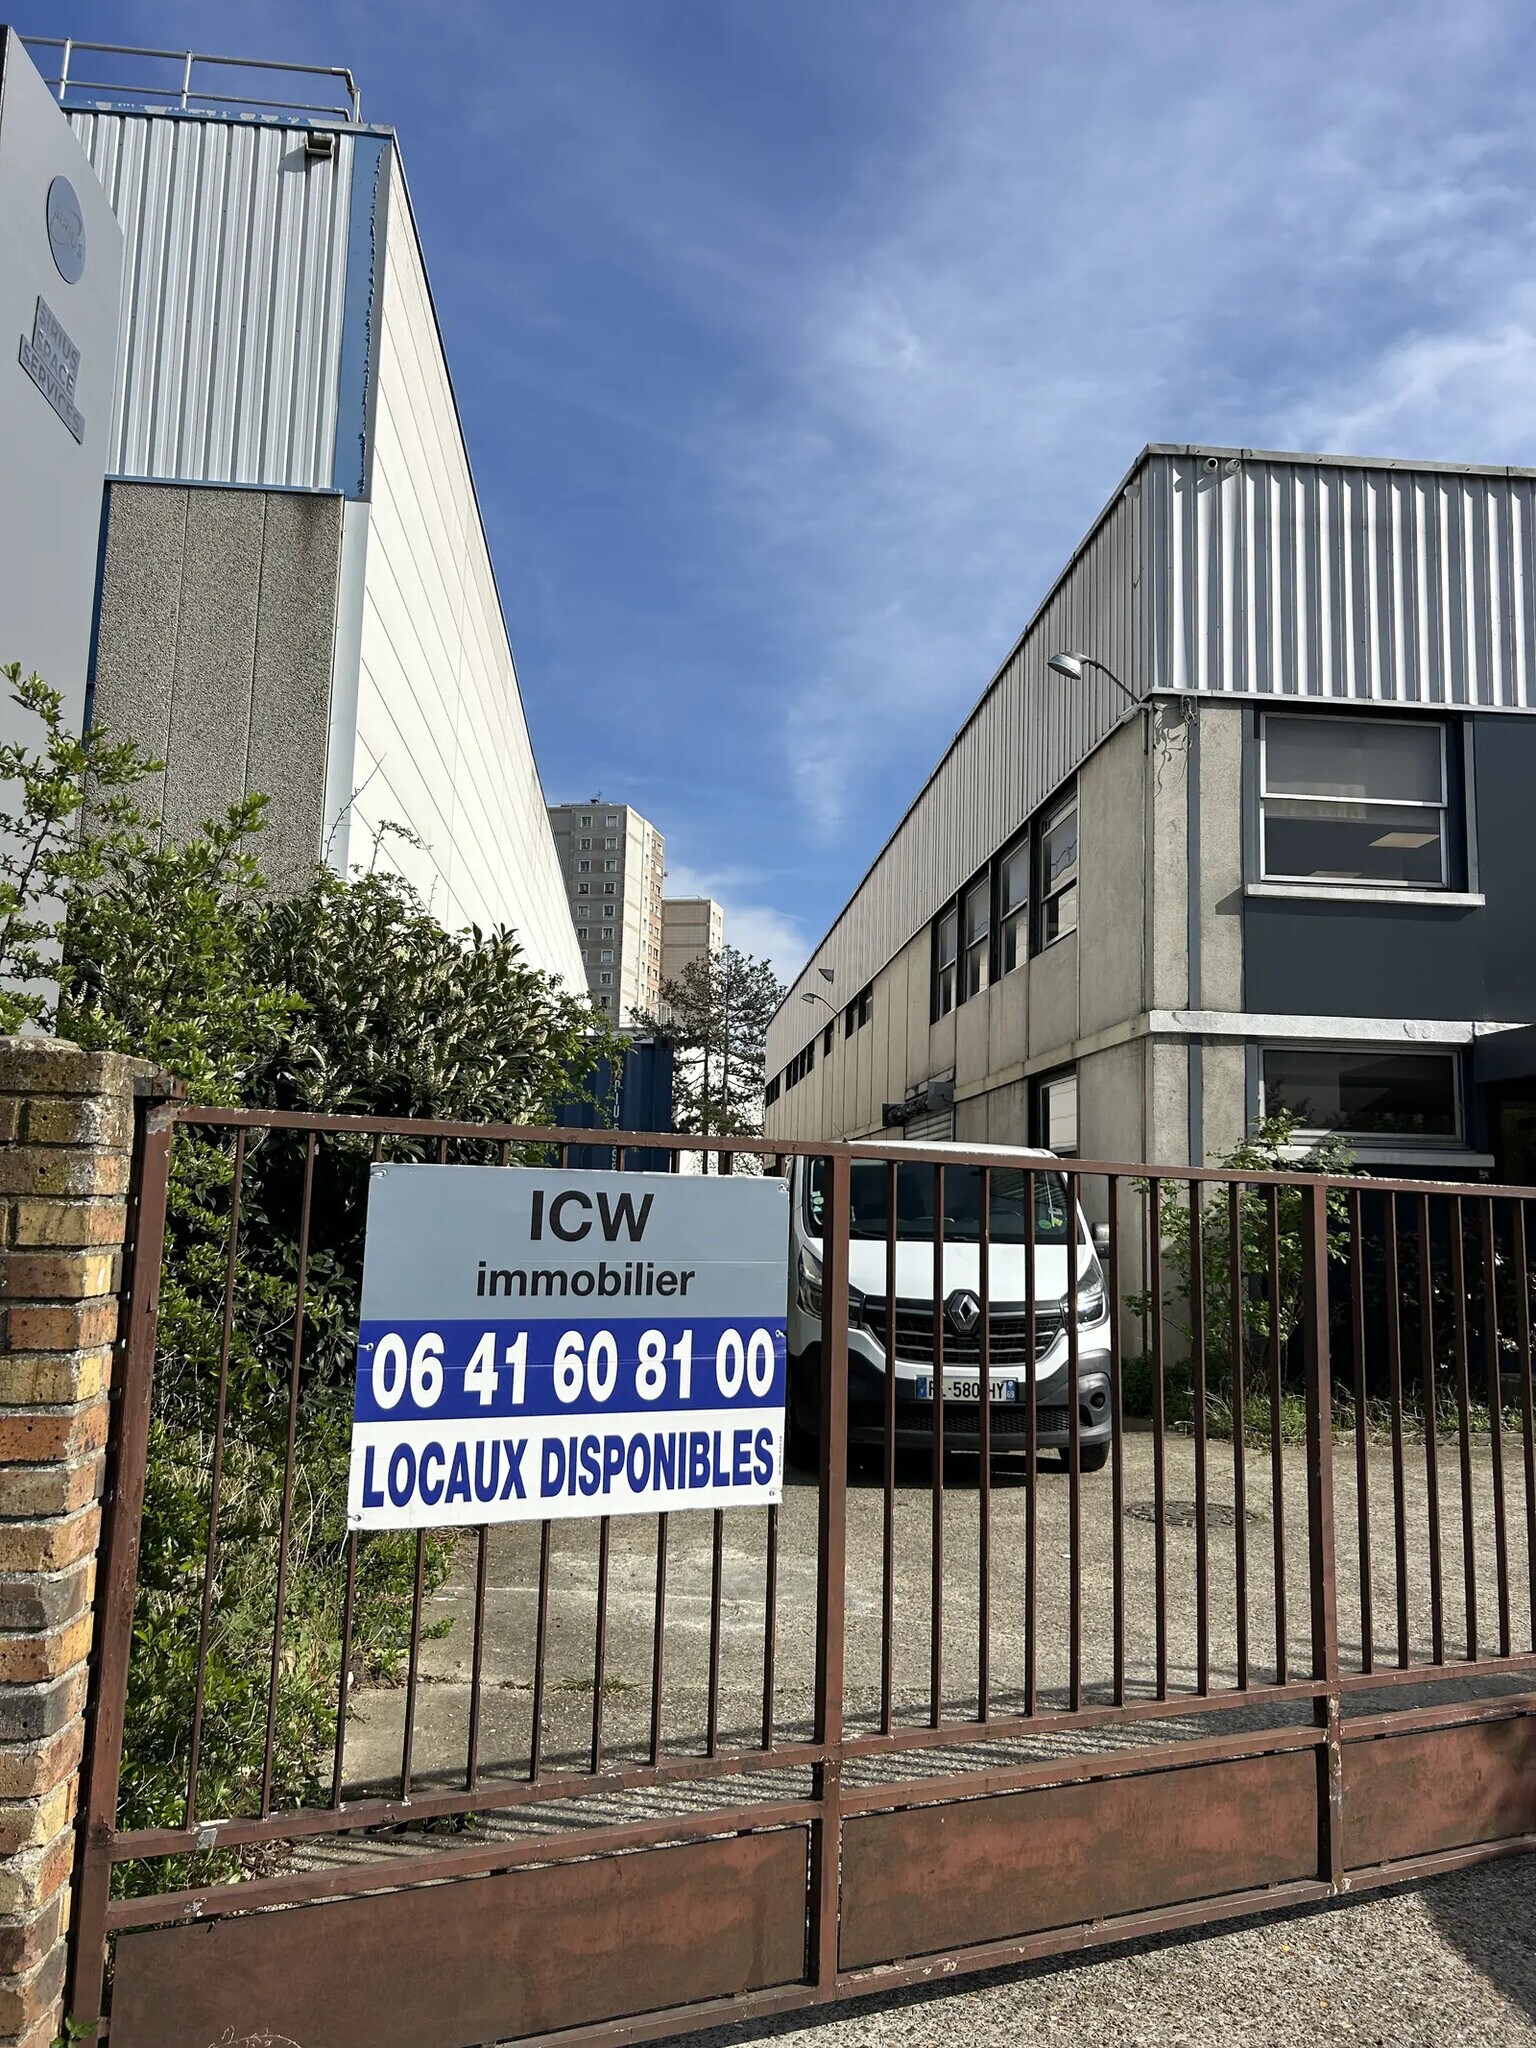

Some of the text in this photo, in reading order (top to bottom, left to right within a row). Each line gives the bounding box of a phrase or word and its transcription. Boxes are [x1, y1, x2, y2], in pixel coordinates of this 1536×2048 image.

[37, 329, 75, 397] SPACE
[39, 304, 79, 371] SIRIUS
[22, 343, 80, 434] SERVICES
[530, 1189, 655, 1243] ICW
[476, 1260, 696, 1297] immobilier
[371, 1327, 775, 1410] 06 41 60 81 00
[362, 1437, 529, 1509] LOCAUX
[540, 1427, 774, 1498] DISPONIBLES
